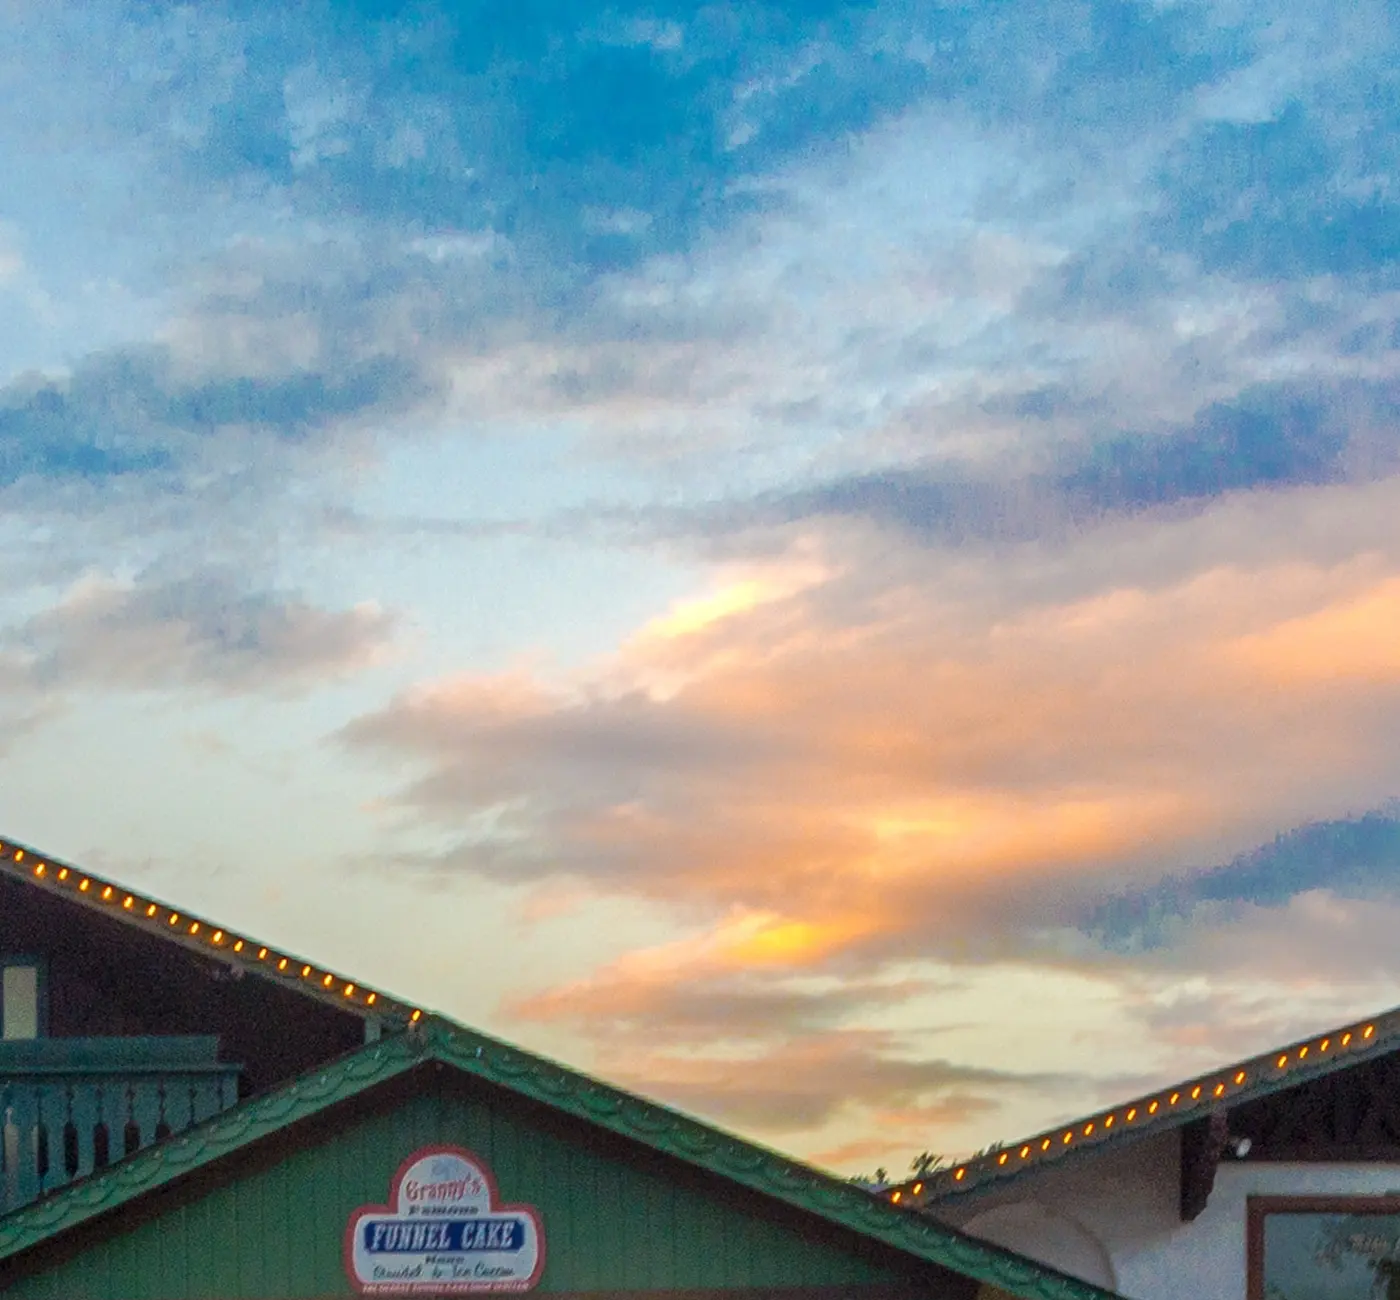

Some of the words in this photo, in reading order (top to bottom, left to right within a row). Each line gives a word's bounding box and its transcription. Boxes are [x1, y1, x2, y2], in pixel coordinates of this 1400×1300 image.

[406, 1173, 482, 1202] Granny's
[371, 1222, 451, 1250] FUNNEL
[461, 1221, 516, 1249] CAKE
